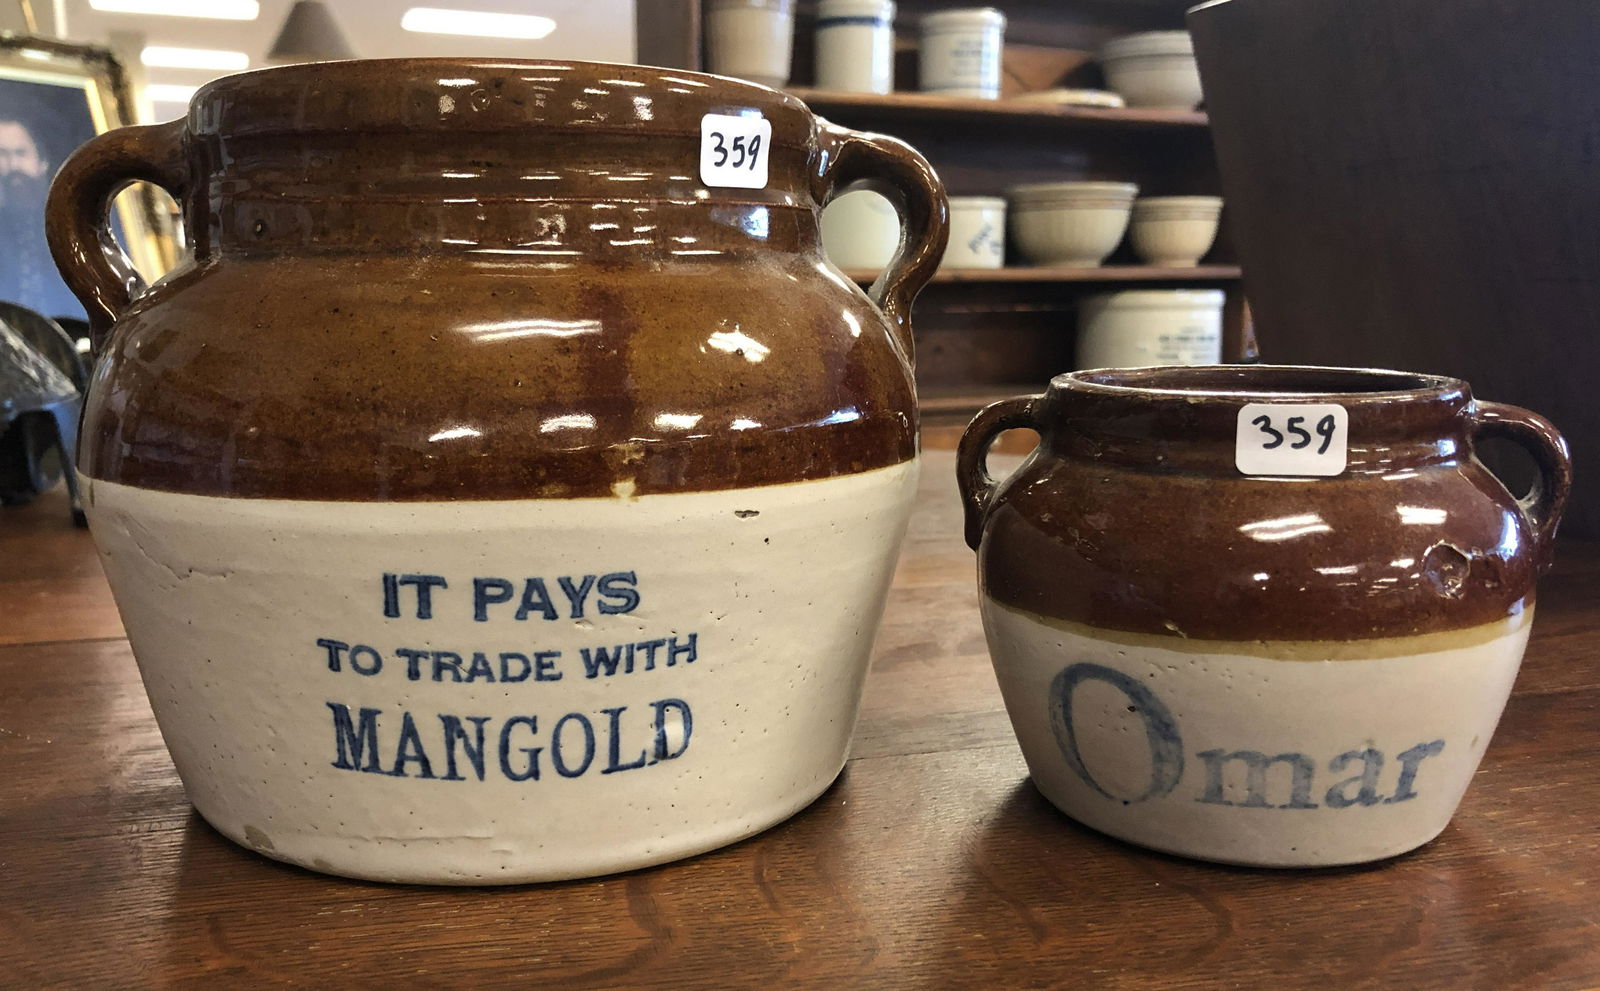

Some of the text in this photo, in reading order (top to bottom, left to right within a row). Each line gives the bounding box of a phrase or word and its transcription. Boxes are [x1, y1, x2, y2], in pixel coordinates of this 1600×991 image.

[710, 132, 761, 171] 359
[1252, 414, 1336, 455] 359
[382, 571, 641, 621] IT PAYS
[316, 633, 698, 683] TO TRADE WITH
[326, 698, 693, 782] MANGOLD
[1048, 662, 1446, 809] Omar
